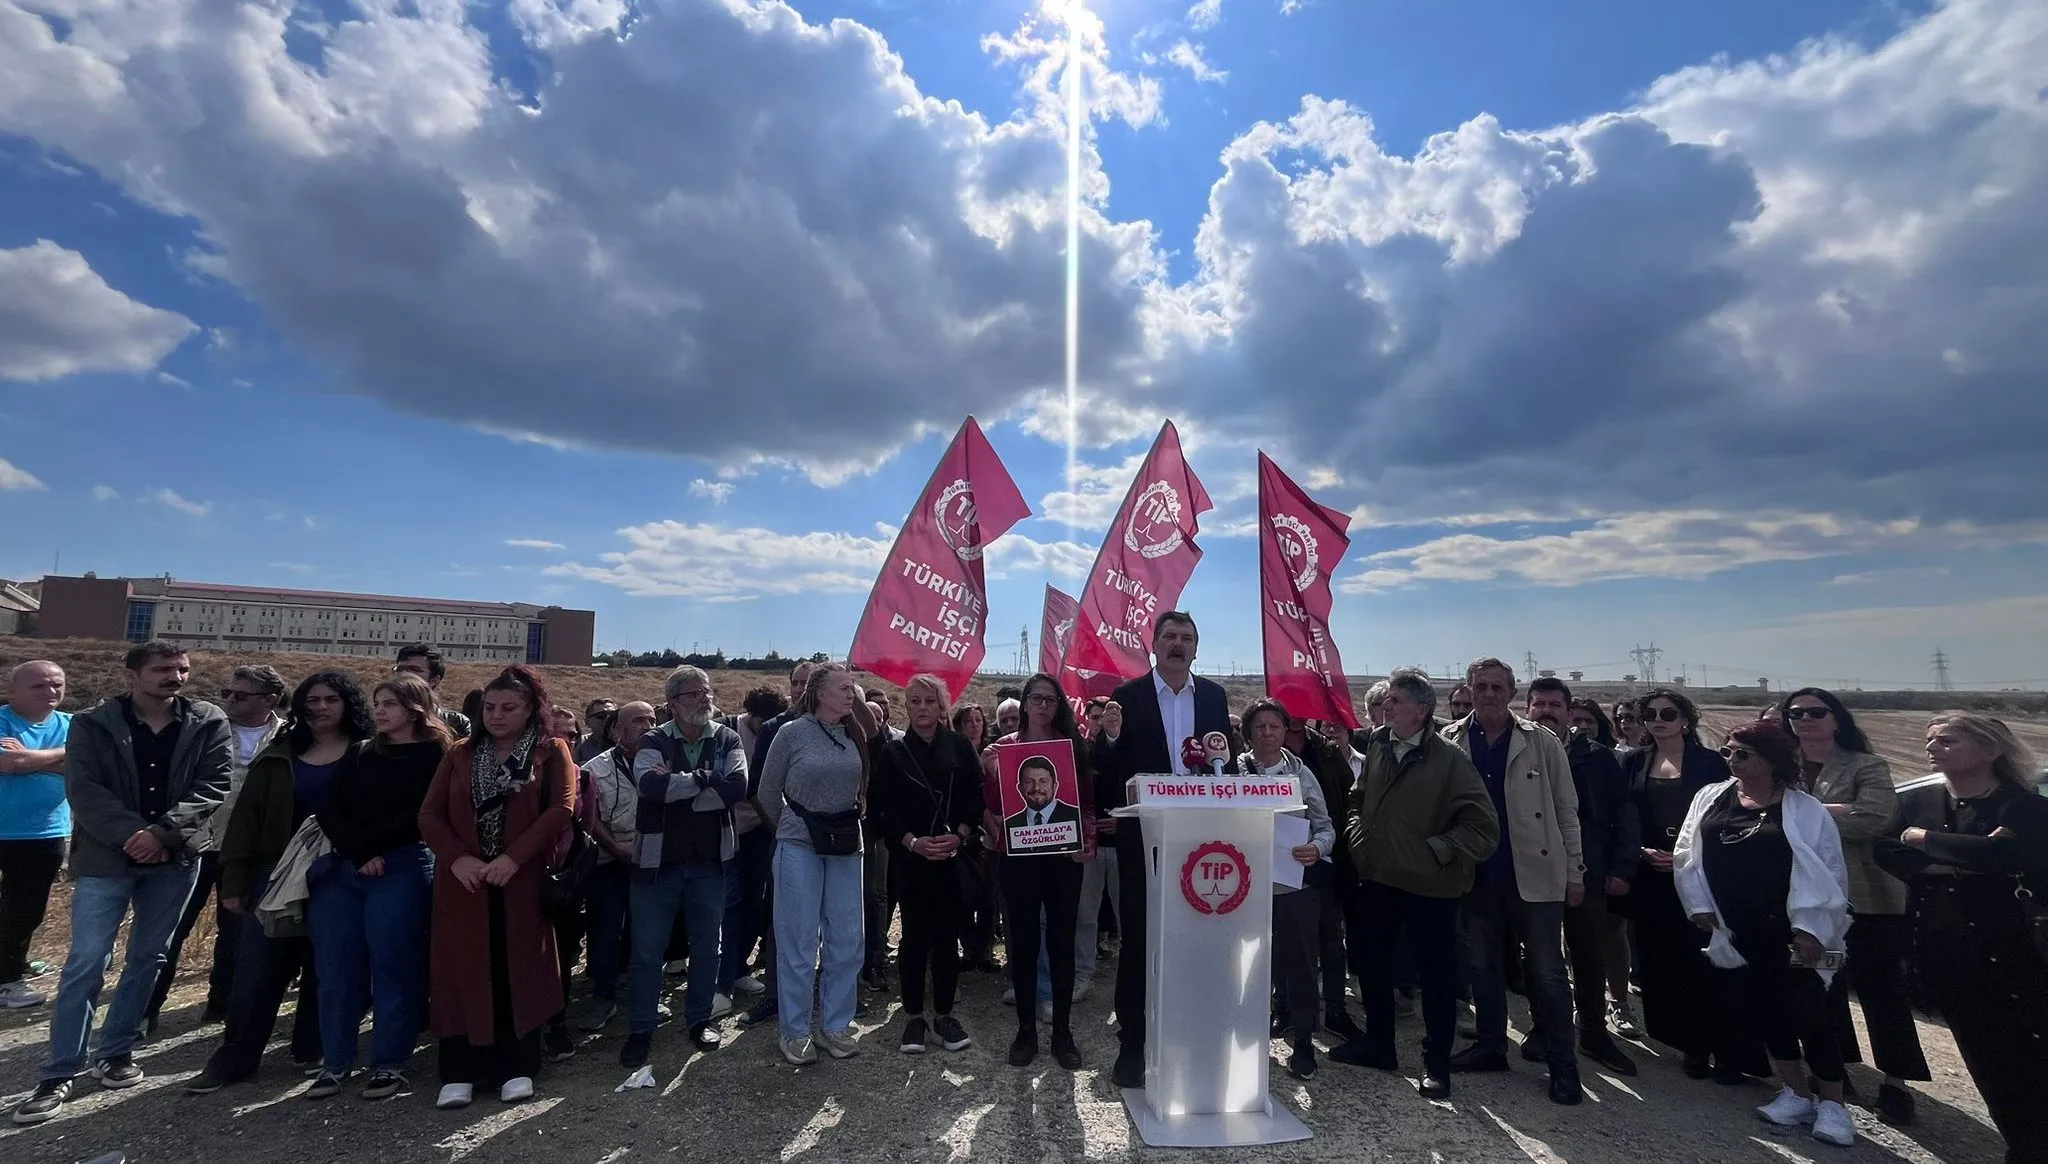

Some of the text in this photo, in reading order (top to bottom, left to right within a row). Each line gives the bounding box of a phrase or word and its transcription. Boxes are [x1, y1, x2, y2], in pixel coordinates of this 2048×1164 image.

[903, 558, 981, 615] TÜRKİYE
[1105, 568, 1158, 613] TÜRKİYE
[937, 601, 979, 637] İŞÇİ
[1125, 600, 1151, 629] İŞÇİ
[889, 612, 971, 661] PARTİSİ
[1148, 782, 1293, 799] TÜRKİYE İŞÇİ PARTİSİ
[1021, 834, 1066, 845] ÖZGÜRLÜK
[1033, 825, 1072, 836] ATALAY'A
